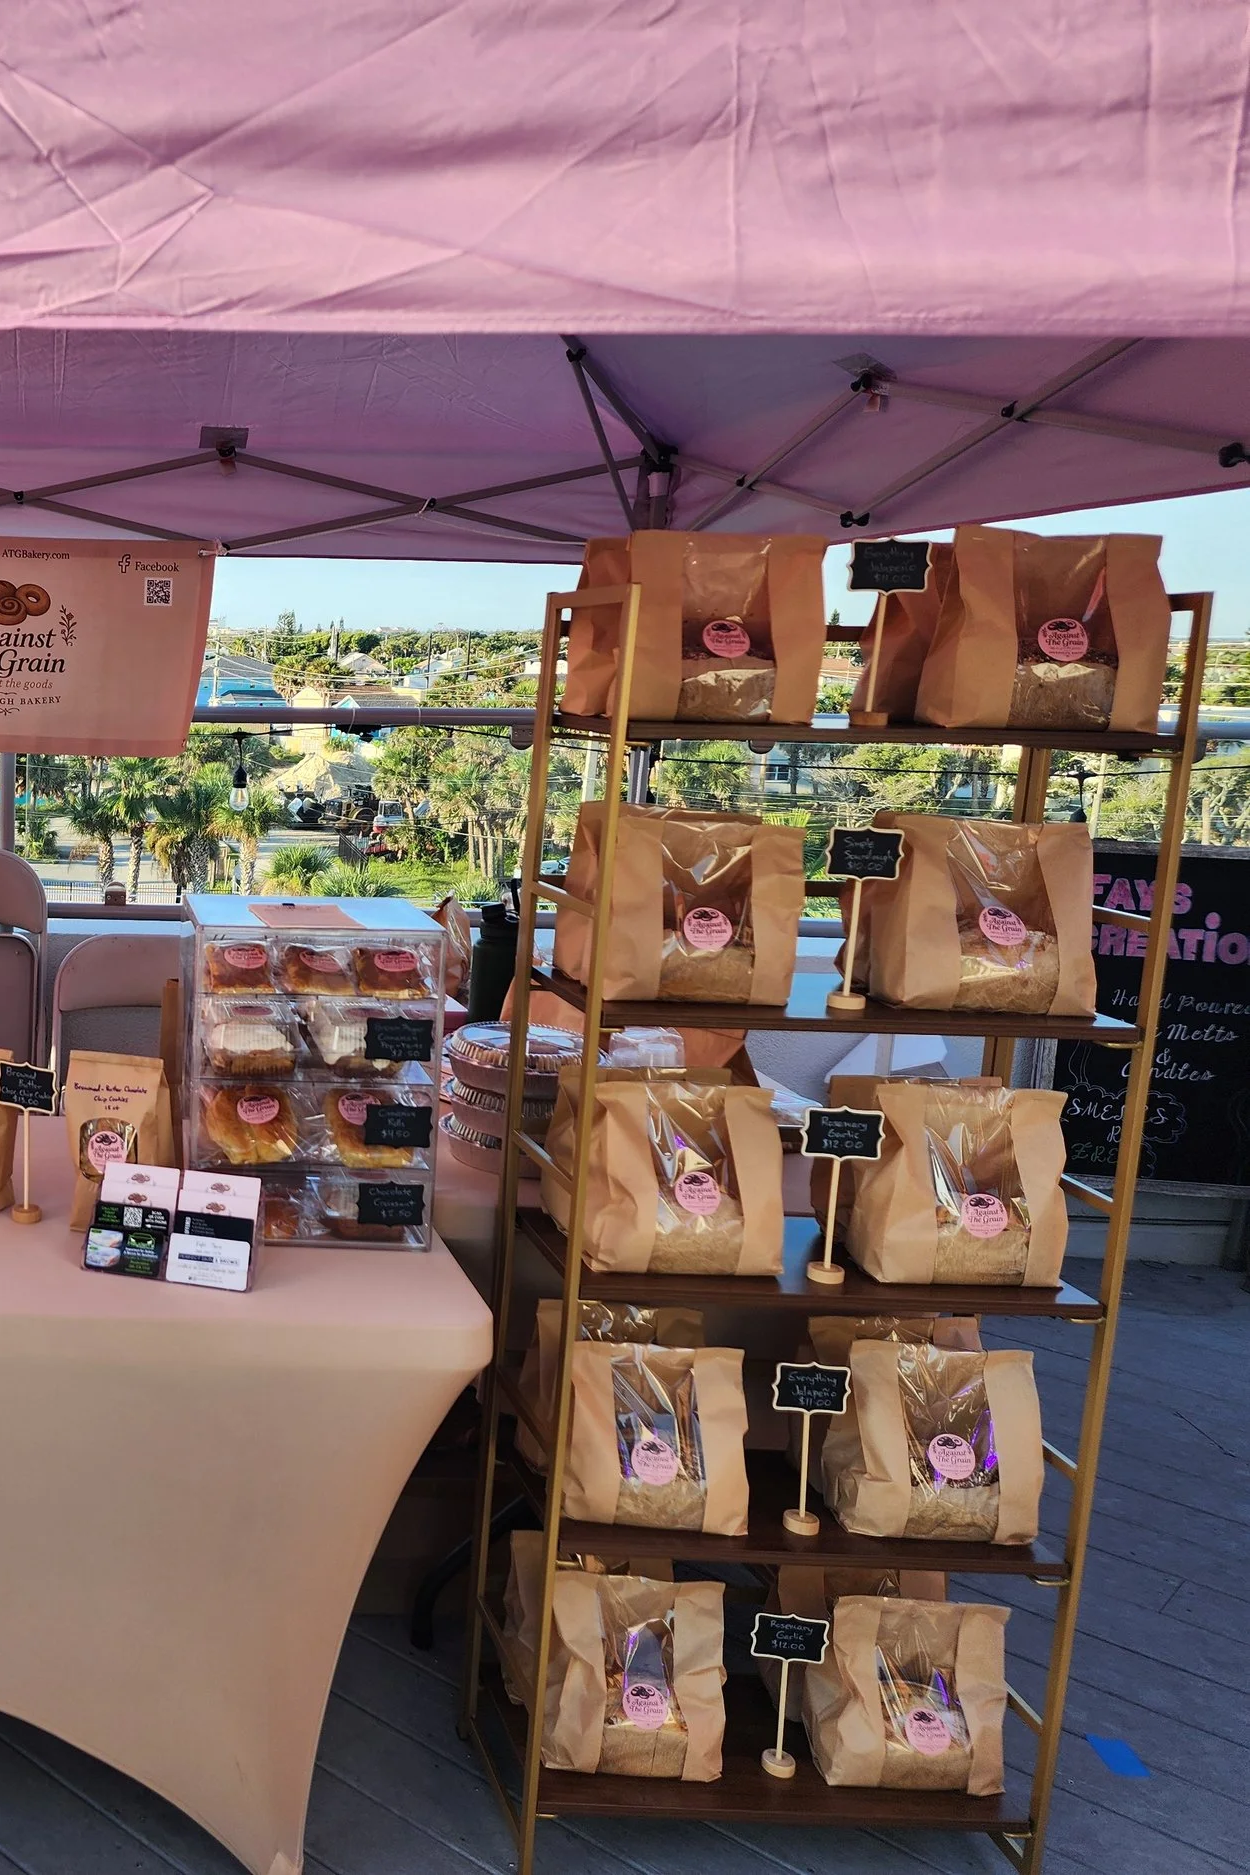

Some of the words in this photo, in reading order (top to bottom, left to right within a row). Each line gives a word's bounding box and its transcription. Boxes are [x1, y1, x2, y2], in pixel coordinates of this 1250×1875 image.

[2, 549, 70, 561] ATGBakery.com
[134, 561, 180, 573] Facebook
[5, 678, 22, 688] the
[24, 680, 53, 690] goods
[19, 695, 62, 706] BAKERY
[844, 849, 896, 864] Sourdough
[1110, 989, 1172, 1009] Had
[1166, 1023, 1240, 1043] Melts
[1121, 1061, 1217, 1082] Cndles
[821, 1115, 868, 1132] Rosemary
[827, 1129, 860, 1139] Garlic
[822, 1138, 864, 1149] $12.00
[788, 1370, 838, 1387] Everything
[791, 1384, 837, 1400] Jalapeño
[770, 1619, 814, 1636] Rosemary
[775, 1630, 805, 1641] Garlic
[771, 1639, 806, 1651] $12.00
